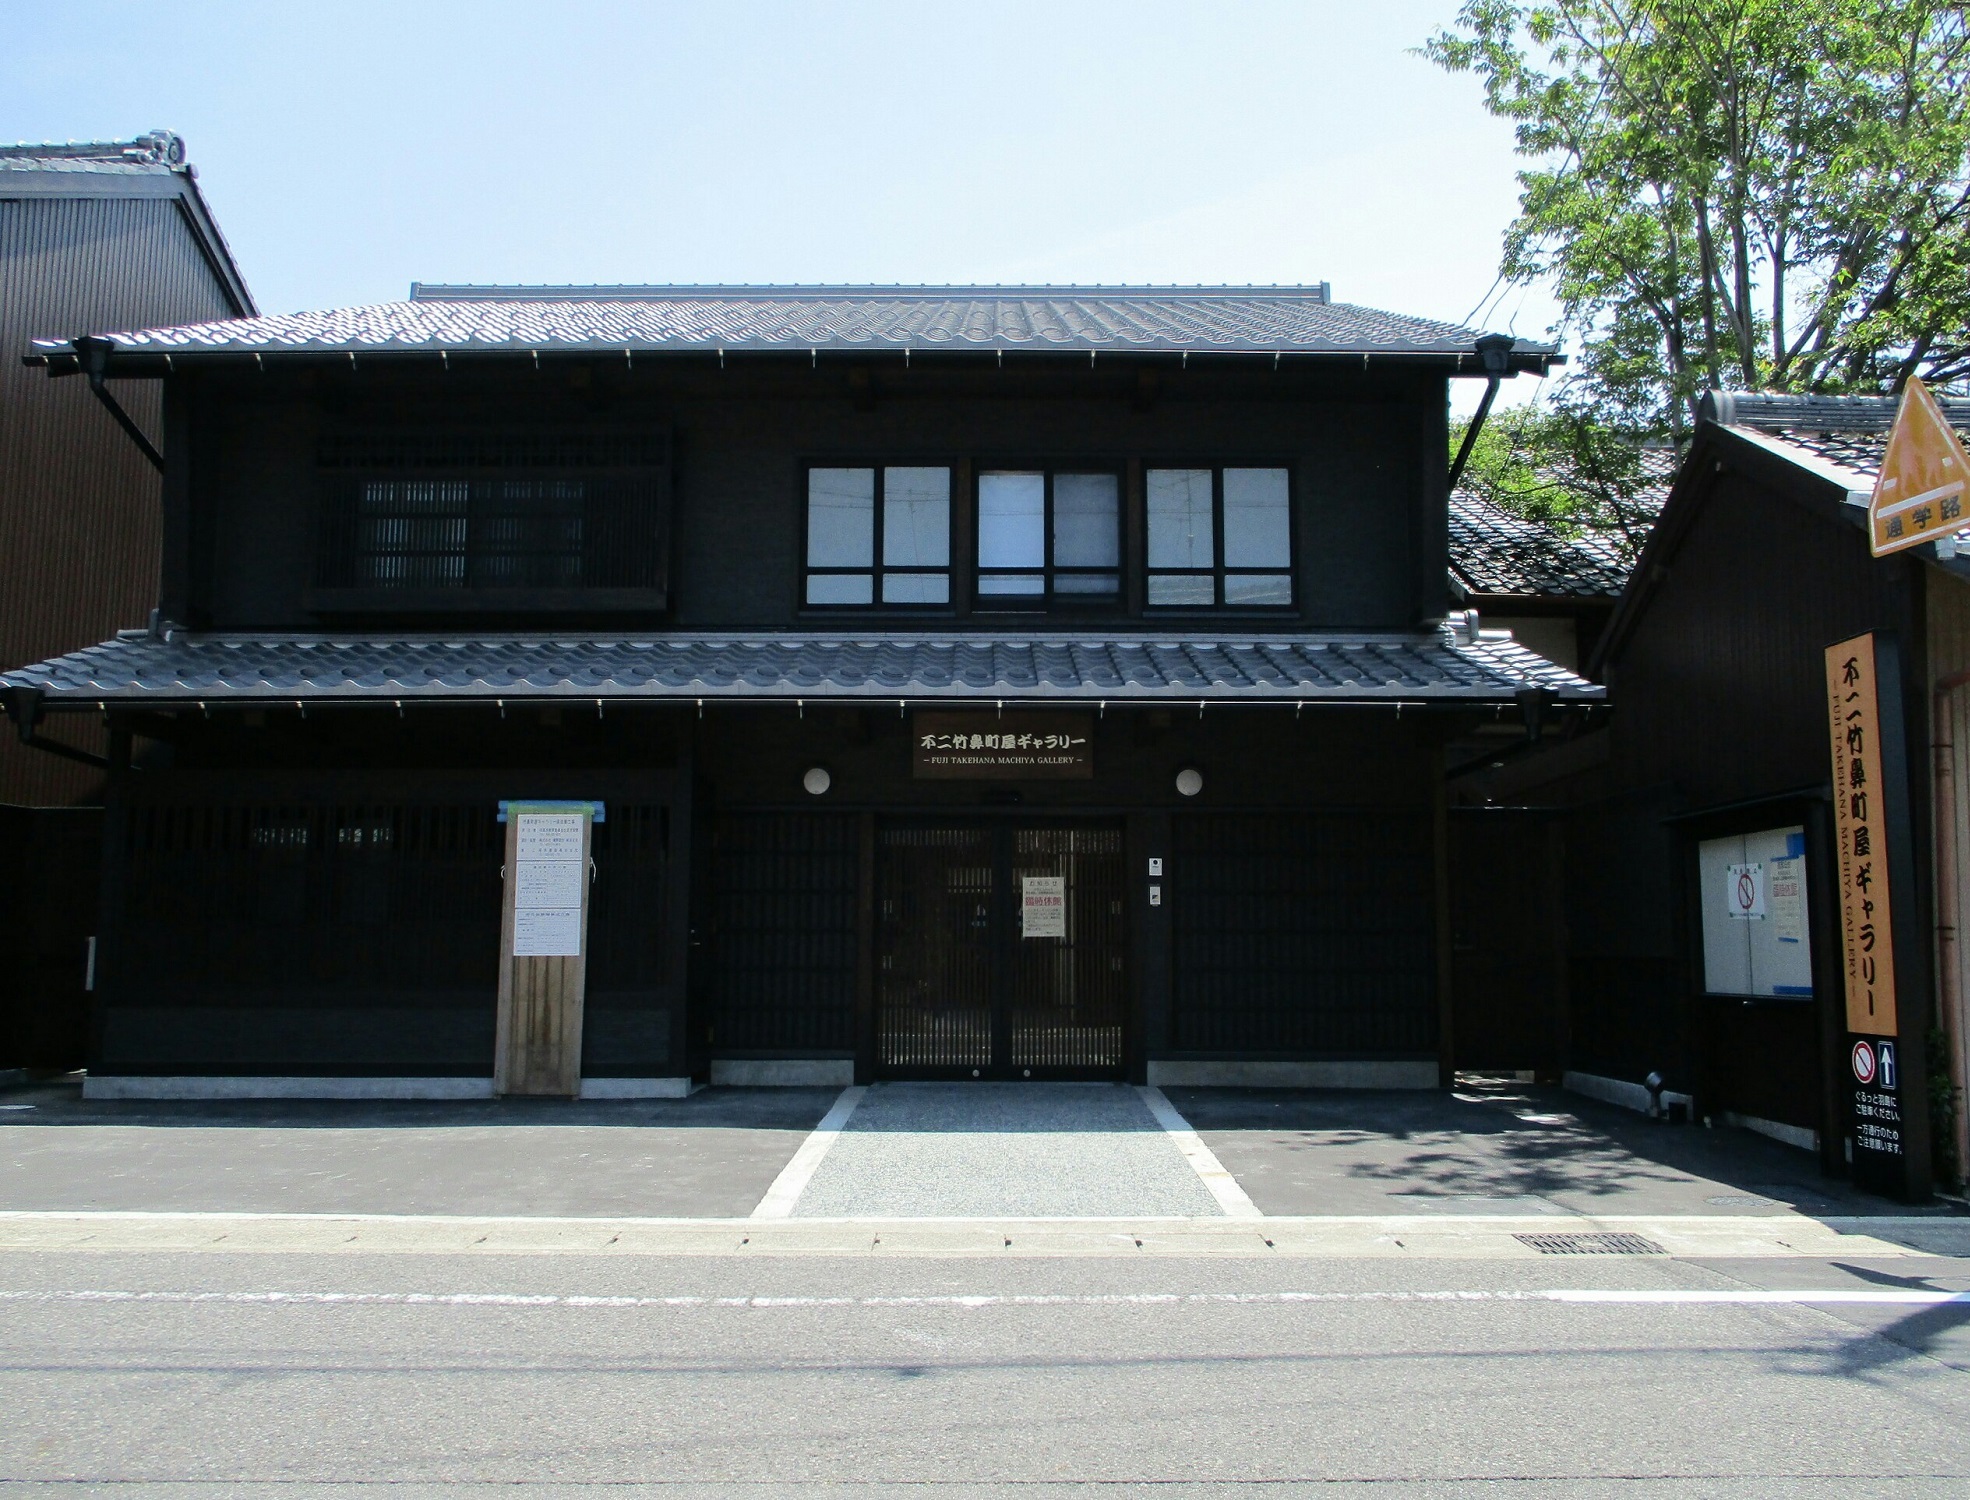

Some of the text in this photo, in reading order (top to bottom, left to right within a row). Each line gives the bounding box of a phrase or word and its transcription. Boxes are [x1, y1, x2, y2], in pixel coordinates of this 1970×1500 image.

[1885, 495, 1962, 540] 通学路
[920, 733, 1086, 750] 不二竹鼻町屋ギャラリー
[931, 756, 1074, 764] FUJI TAKEHANA MACHIYA GALLERY
[1832, 694, 1857, 980] FUJI TAKEHANA MACHIYA GALLERY
[1842, 656, 1876, 1017] 不二竹鼻町屋ギャラリー
